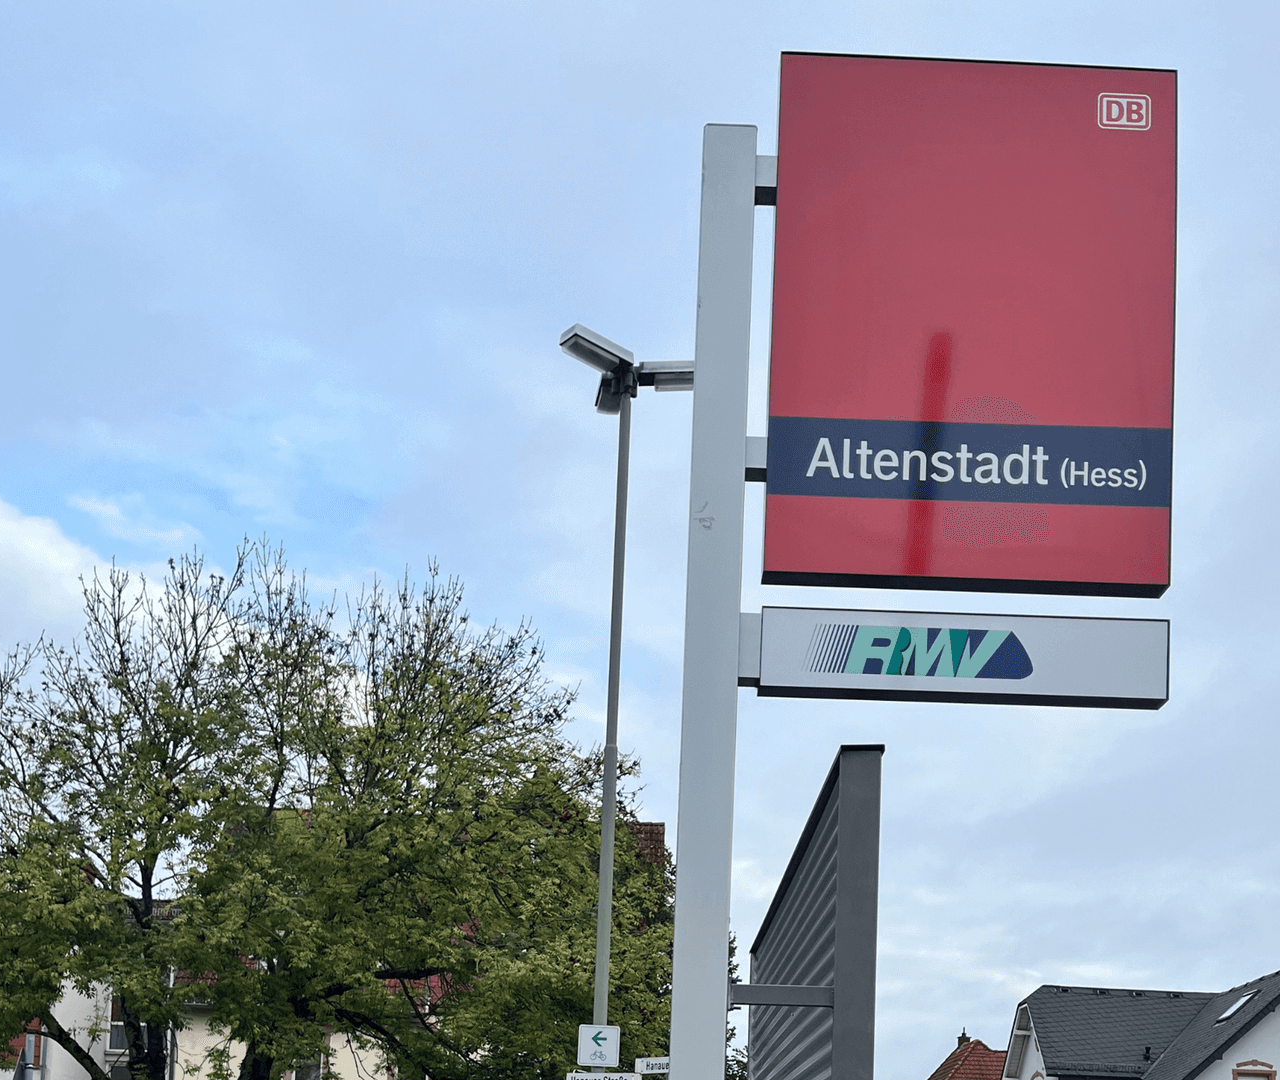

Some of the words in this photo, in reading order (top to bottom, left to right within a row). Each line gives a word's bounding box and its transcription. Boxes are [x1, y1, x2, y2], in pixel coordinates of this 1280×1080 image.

[1104, 98, 1146, 125] DB
[805, 437, 1049, 485] Altenstadt
[1059, 457, 1147, 491] (Hess)
[844, 625, 1011, 678] RMV
